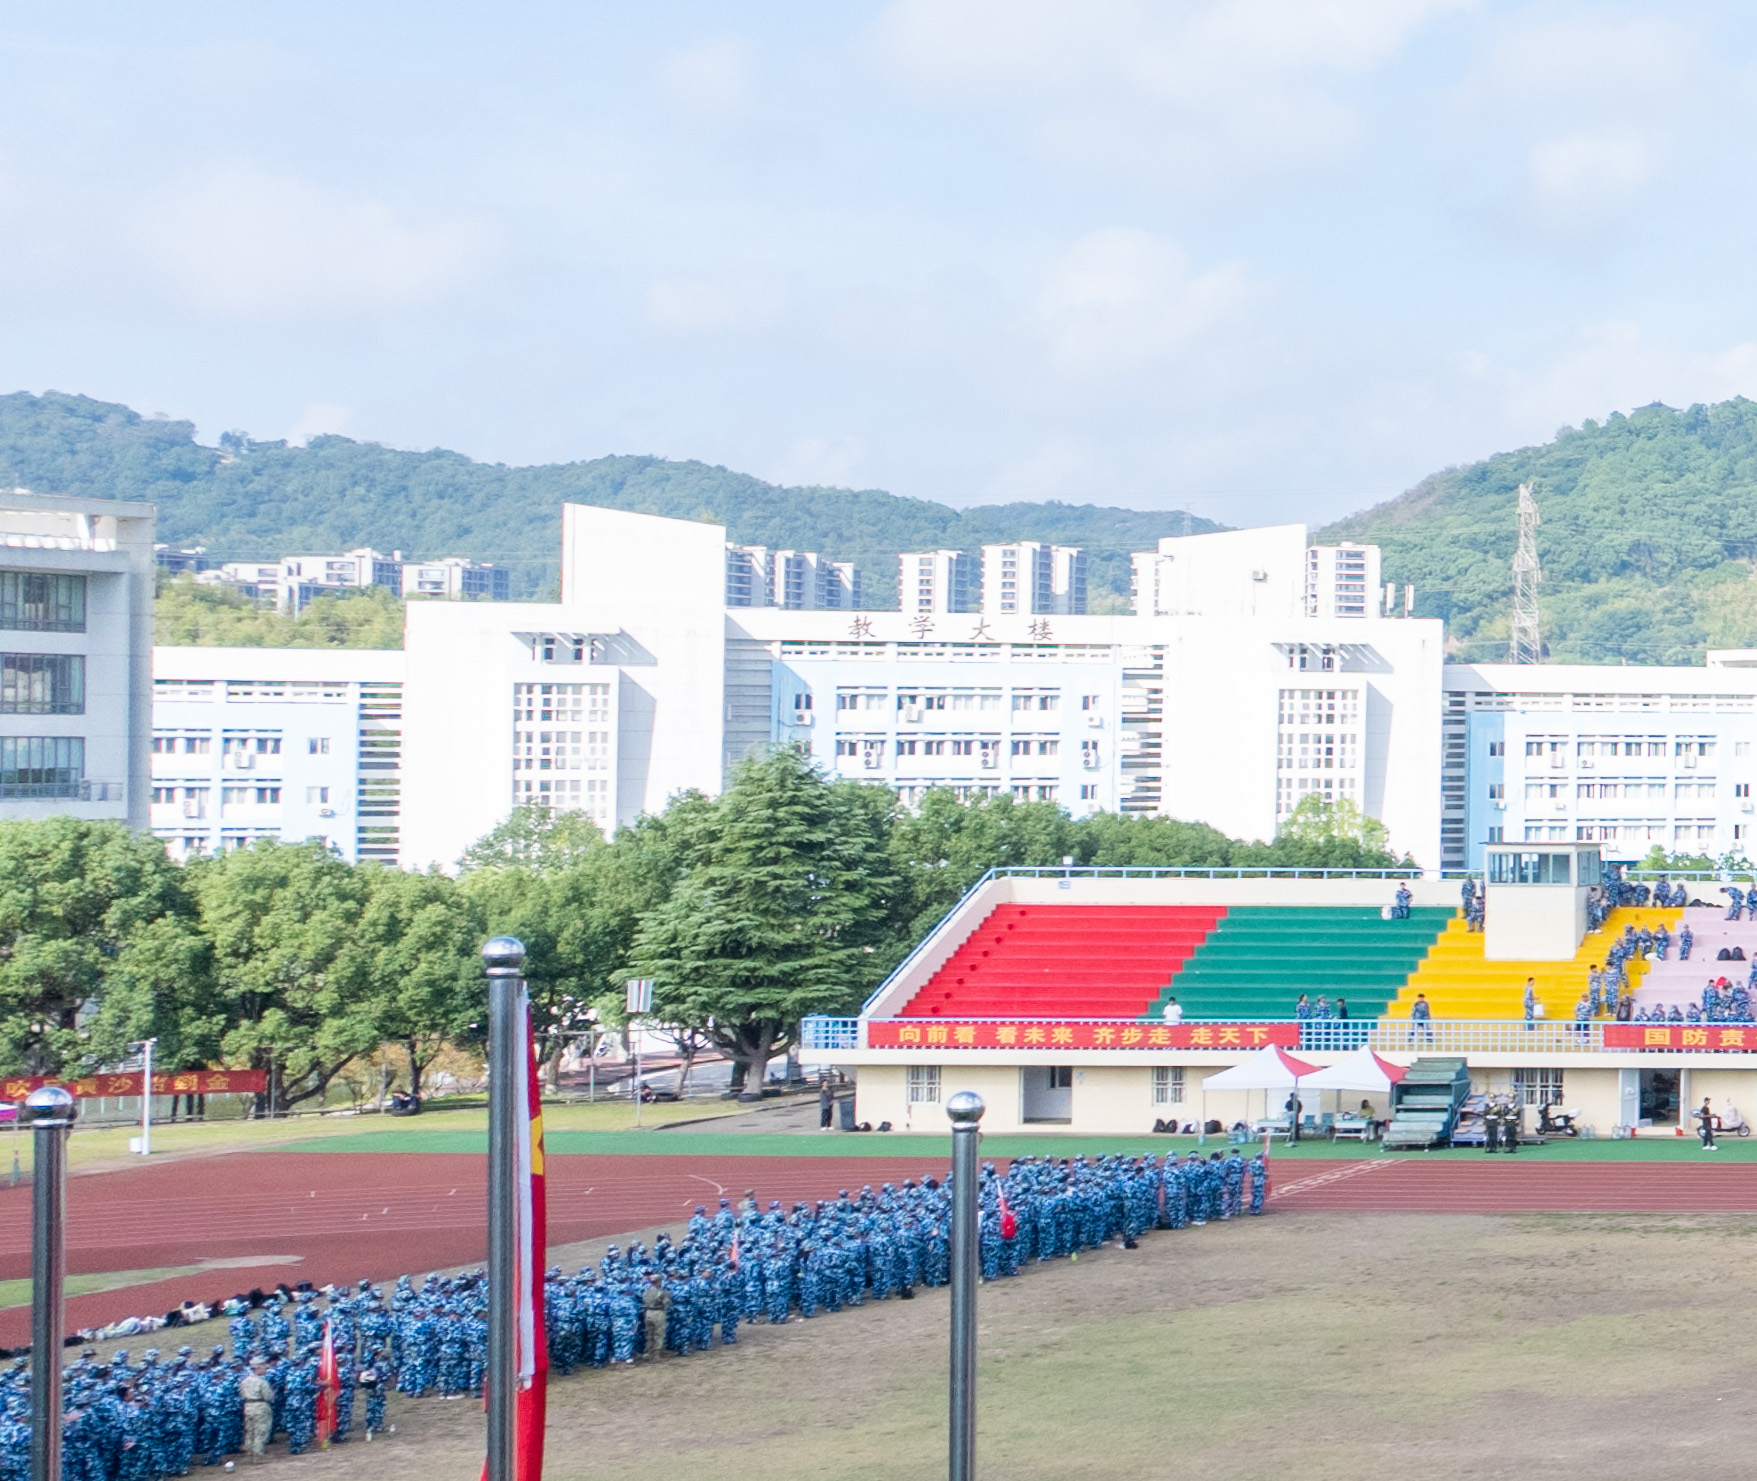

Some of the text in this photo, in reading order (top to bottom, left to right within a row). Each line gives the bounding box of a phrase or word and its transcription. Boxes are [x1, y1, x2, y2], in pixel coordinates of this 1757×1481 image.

[848, 614, 1056, 641] 教学大楼
[898, 1025, 1271, 1046] 向前看 看未来 齐步走 走天下
